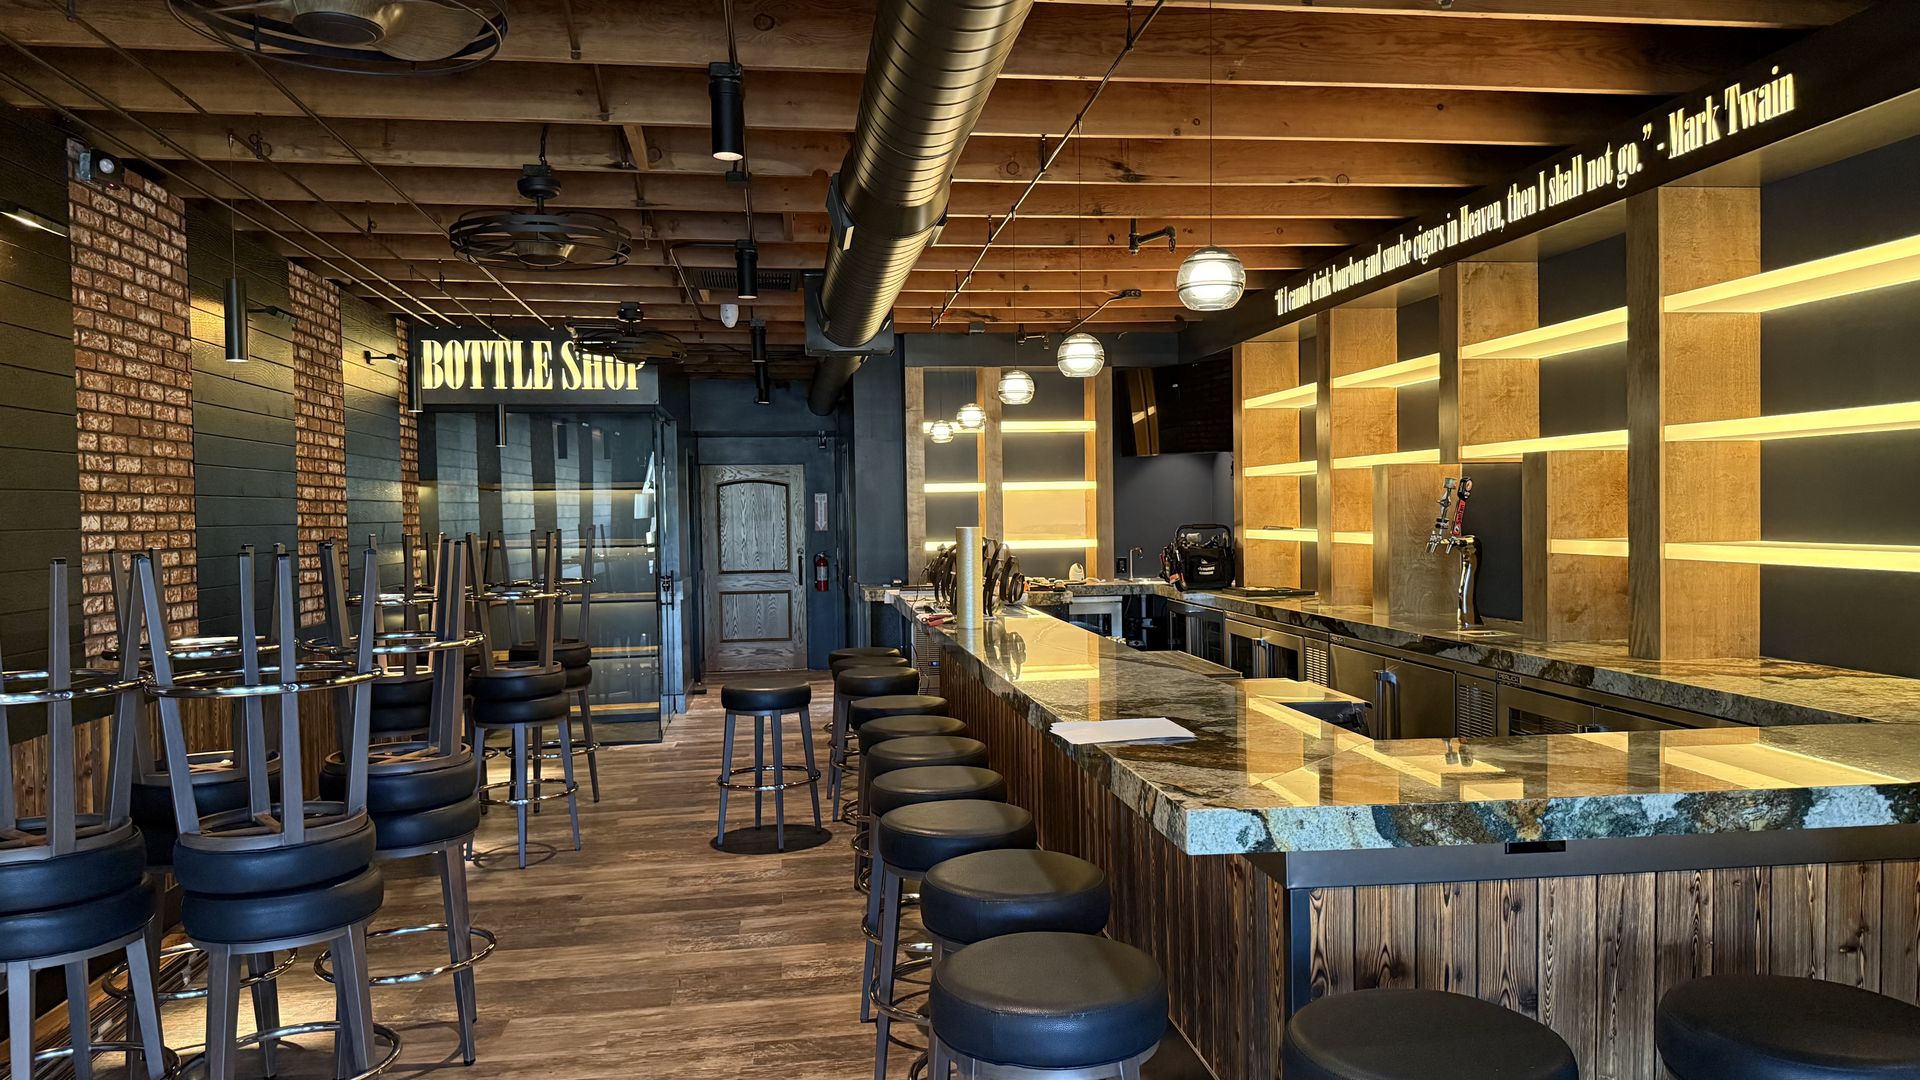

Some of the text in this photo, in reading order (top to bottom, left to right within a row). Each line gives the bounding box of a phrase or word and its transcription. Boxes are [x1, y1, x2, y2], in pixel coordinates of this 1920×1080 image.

[1284, 286, 1288, 313] I
[1288, 278, 1311, 312] cannot
[1312, 267, 1332, 302] drink
[1332, 256, 1365, 293] bourbon
[1365, 244, 1381, 281] and
[1382, 233, 1412, 273] smoke
[1413, 225, 1444, 265] cigars
[1446, 213, 1458, 248] in
[1459, 200, 1505, 243] Heaven,
[1507, 183, 1536, 223] then
[1538, 170, 1546, 211] I
[1548, 154, 1583, 207] shall
[1587, 141, 1614, 192] not
[1668, 95, 1721, 160] Mark
[1724, 65, 1795, 136] Twain
[421, 339, 553, 390] BOTTLE
